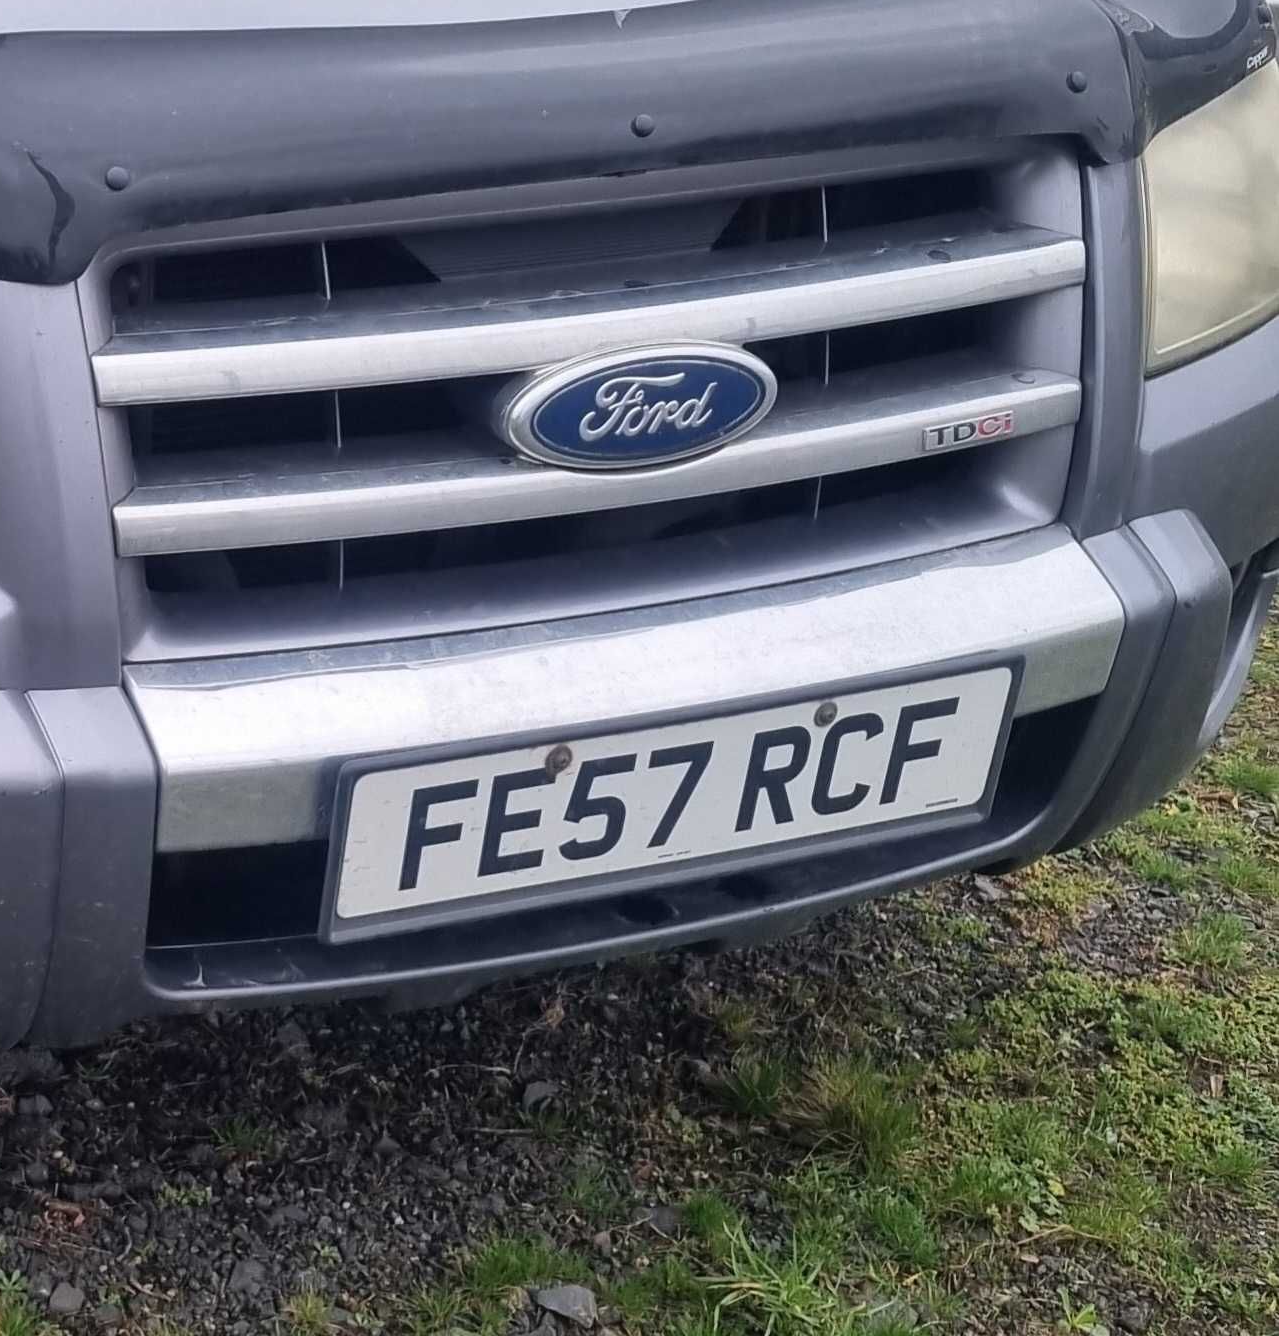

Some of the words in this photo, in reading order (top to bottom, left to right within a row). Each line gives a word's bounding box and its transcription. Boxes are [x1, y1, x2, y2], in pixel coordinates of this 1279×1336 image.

[579, 372, 718, 442] Ford
[929, 411, 1013, 446] TDCi
[398, 741, 715, 891] FE57
[734, 696, 960, 832] RCF
